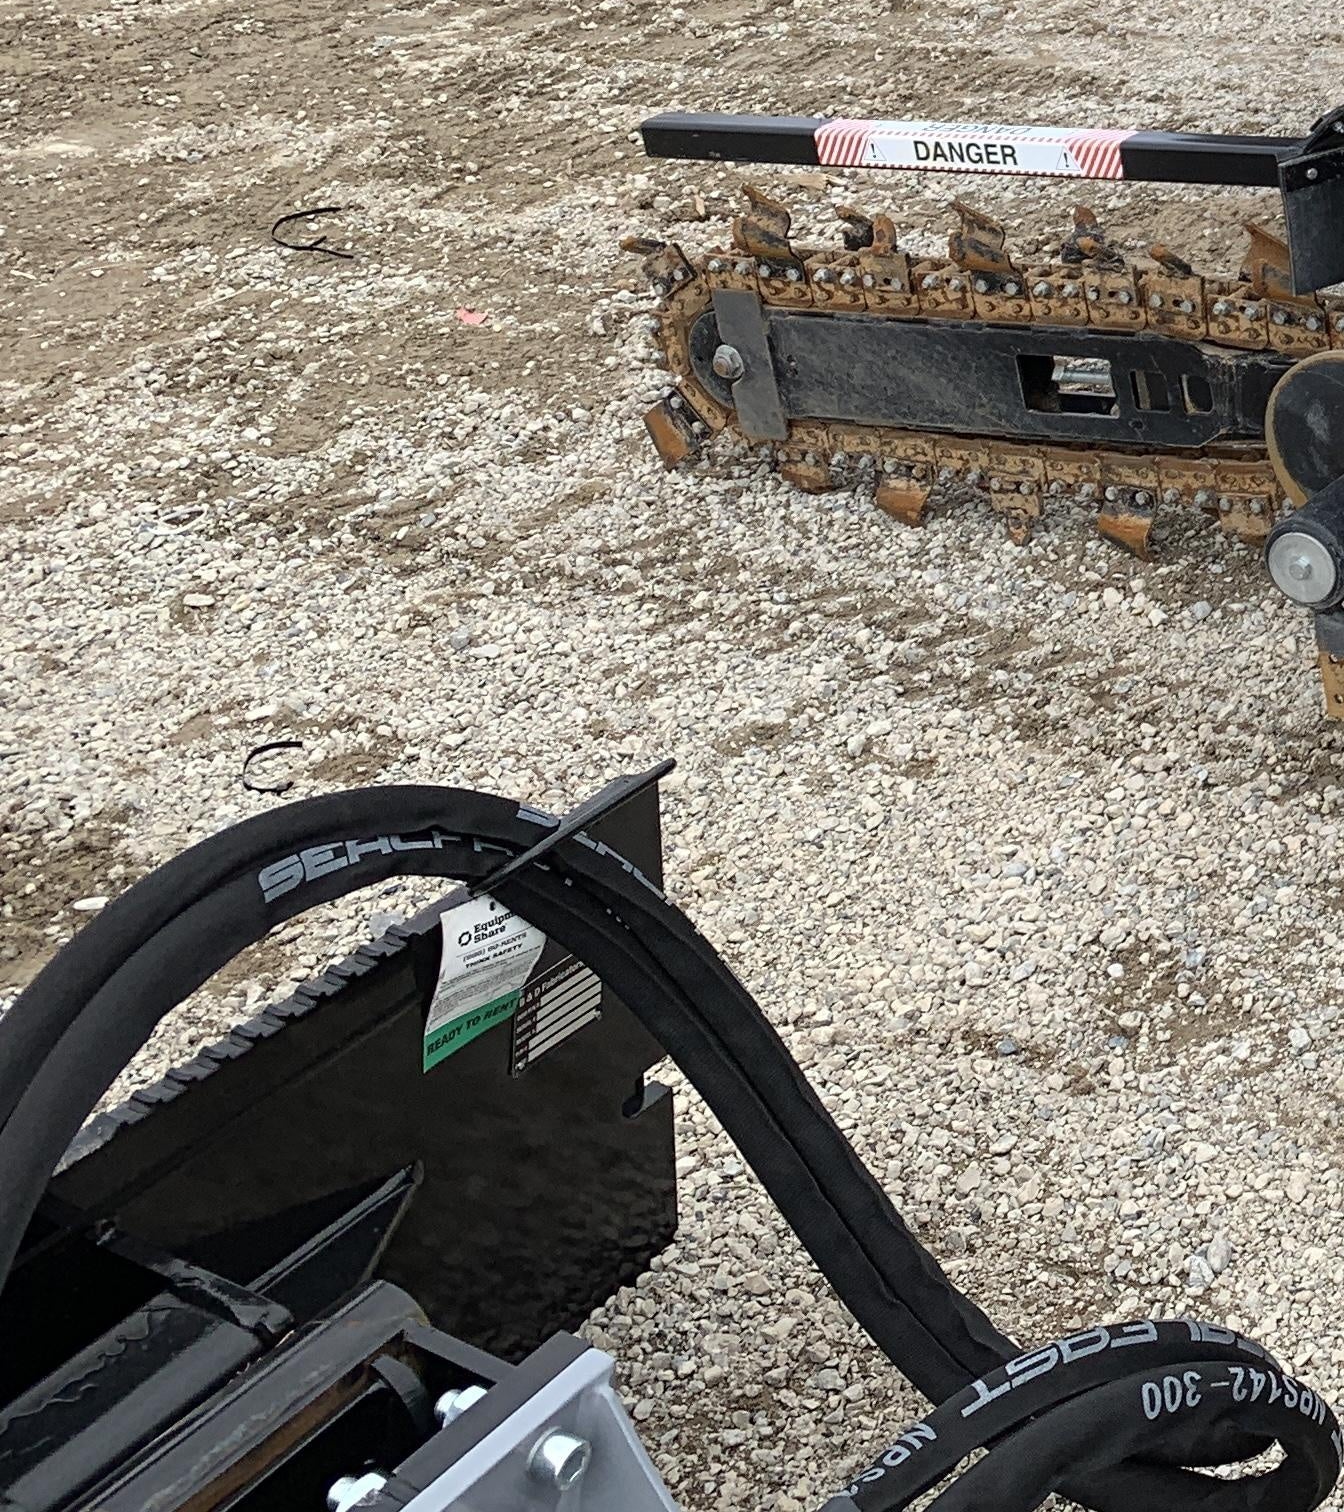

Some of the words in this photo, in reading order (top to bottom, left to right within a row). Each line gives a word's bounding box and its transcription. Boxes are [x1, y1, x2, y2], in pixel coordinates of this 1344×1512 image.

[912, 139, 1019, 166] DANGER
[473, 924, 506, 945] Share
[426, 1024, 465, 1057] READY
[465, 1011, 482, 1031] TO
